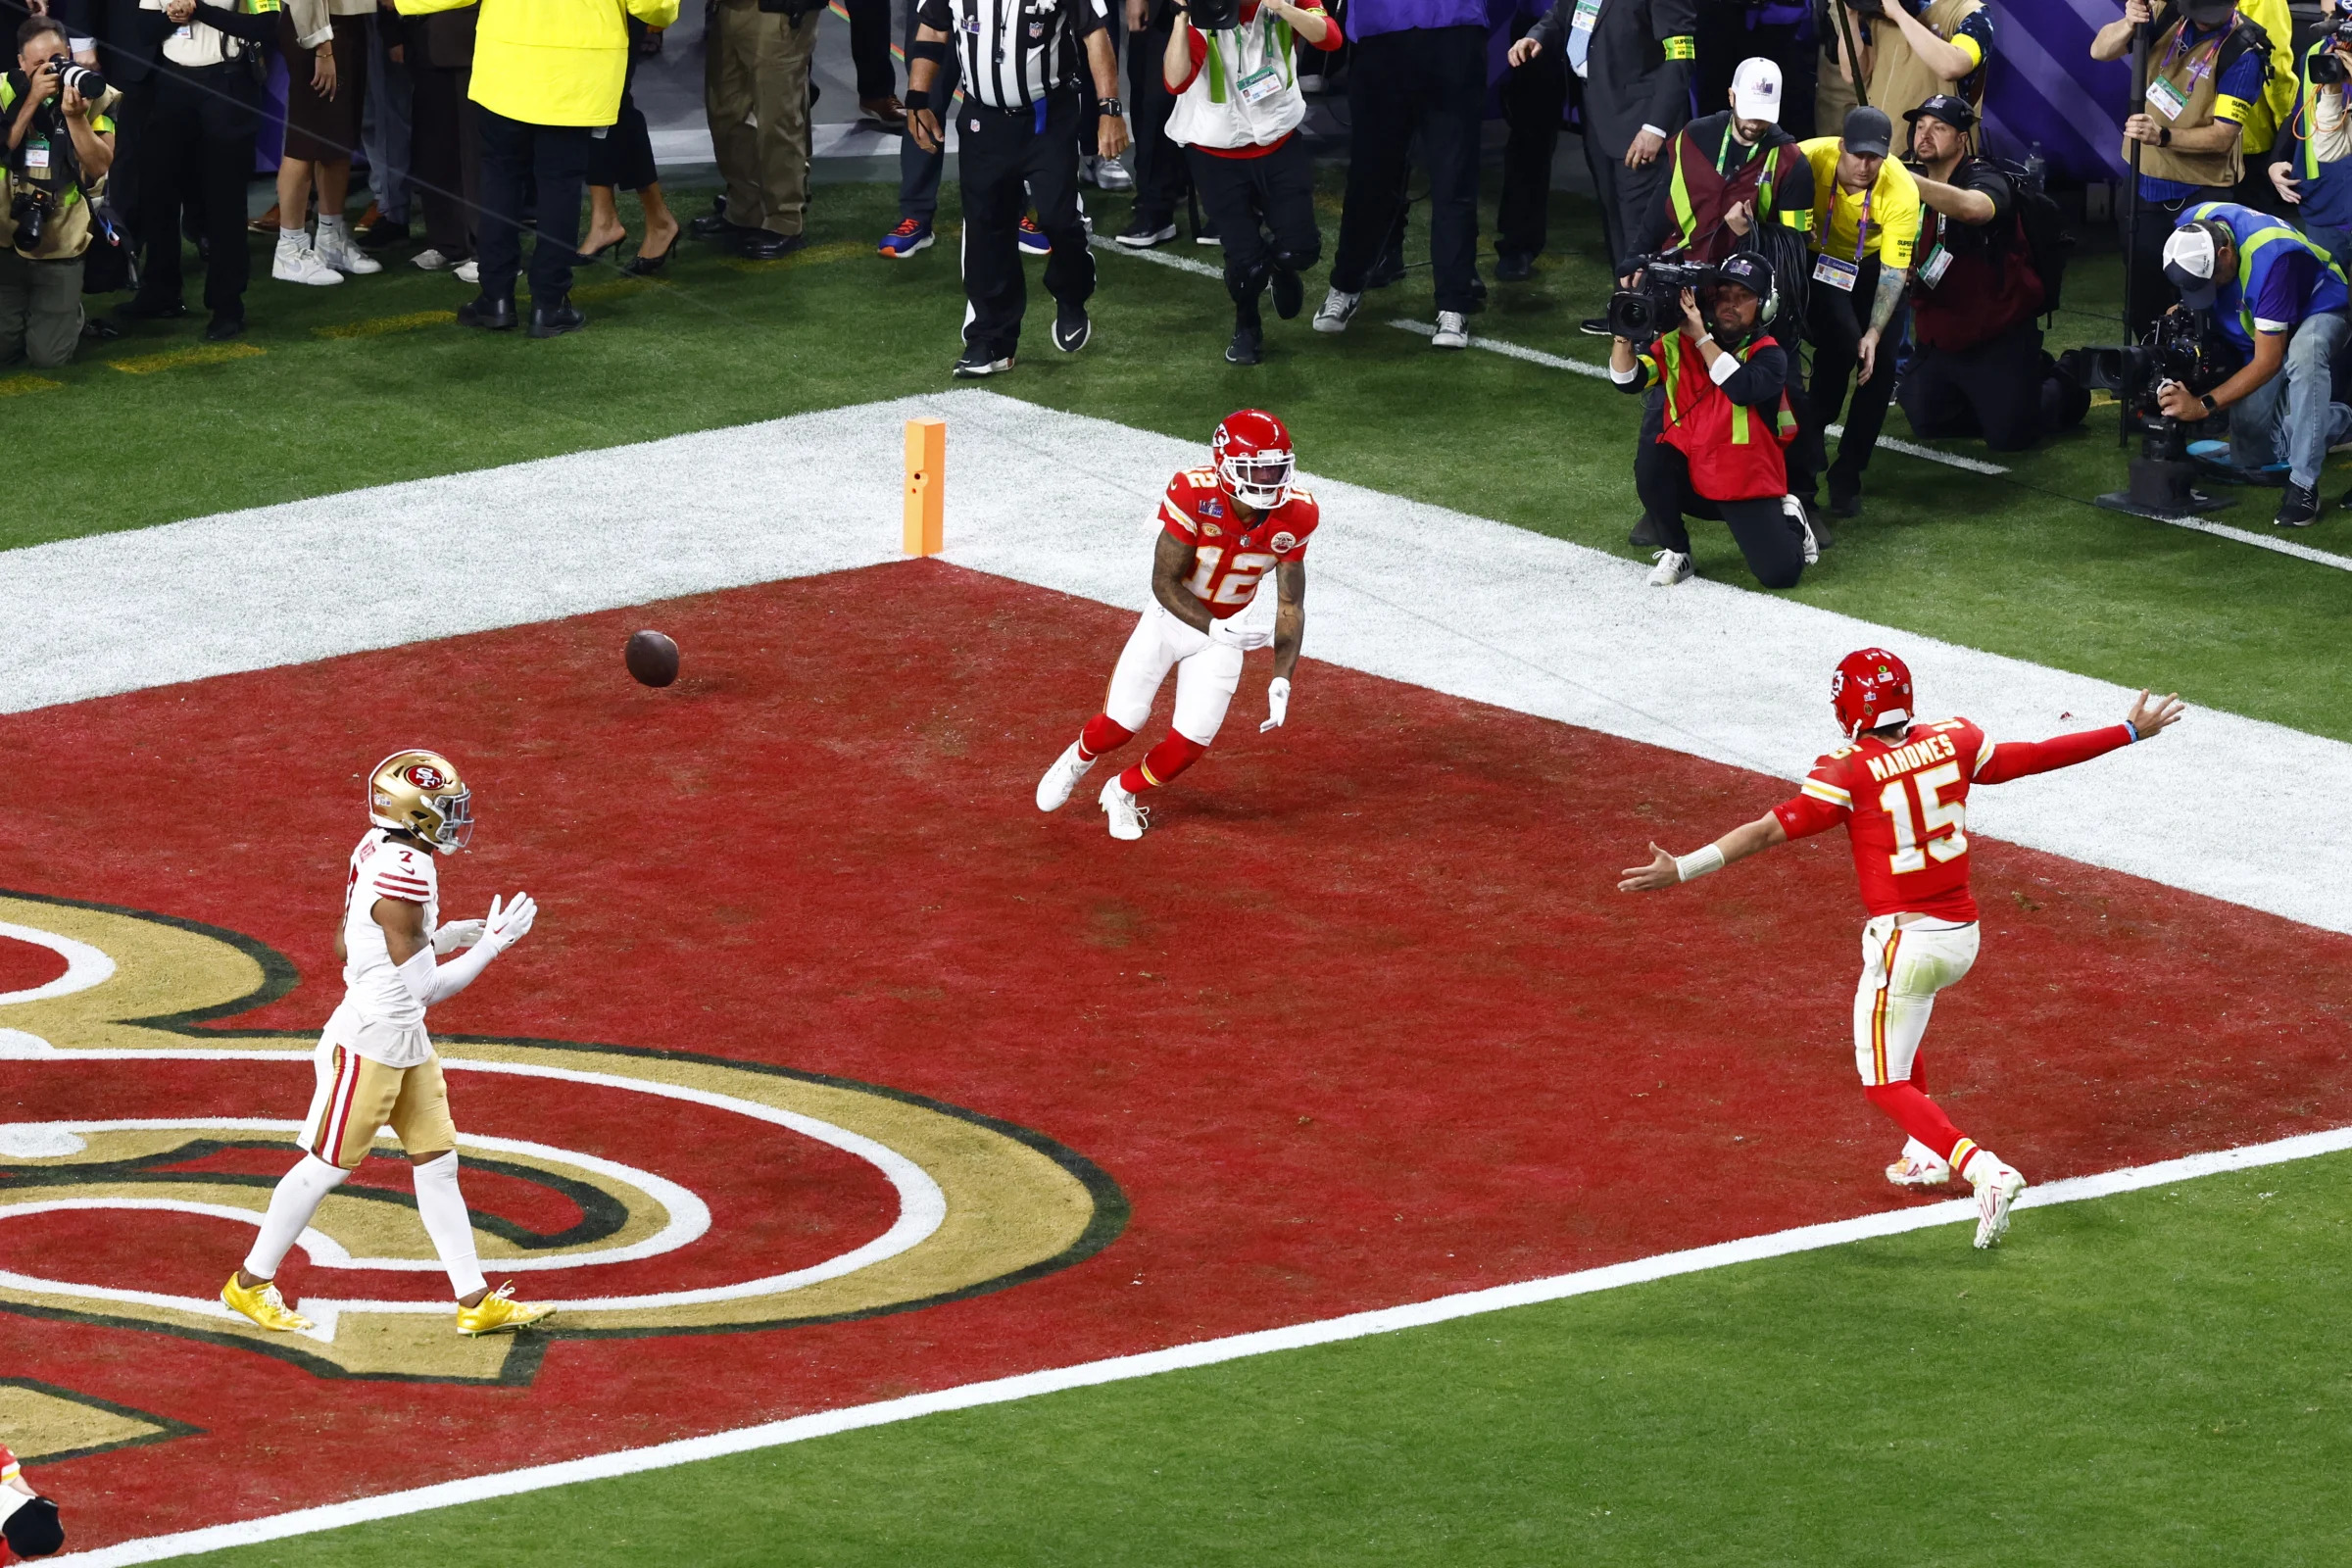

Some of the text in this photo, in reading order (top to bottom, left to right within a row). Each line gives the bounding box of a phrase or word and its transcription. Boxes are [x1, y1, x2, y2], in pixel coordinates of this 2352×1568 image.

[1181, 545, 1279, 605] 12
[1865, 733, 1957, 783] MAHOMES
[1879, 760, 1969, 875] 15
[398, 850, 415, 863] 7
